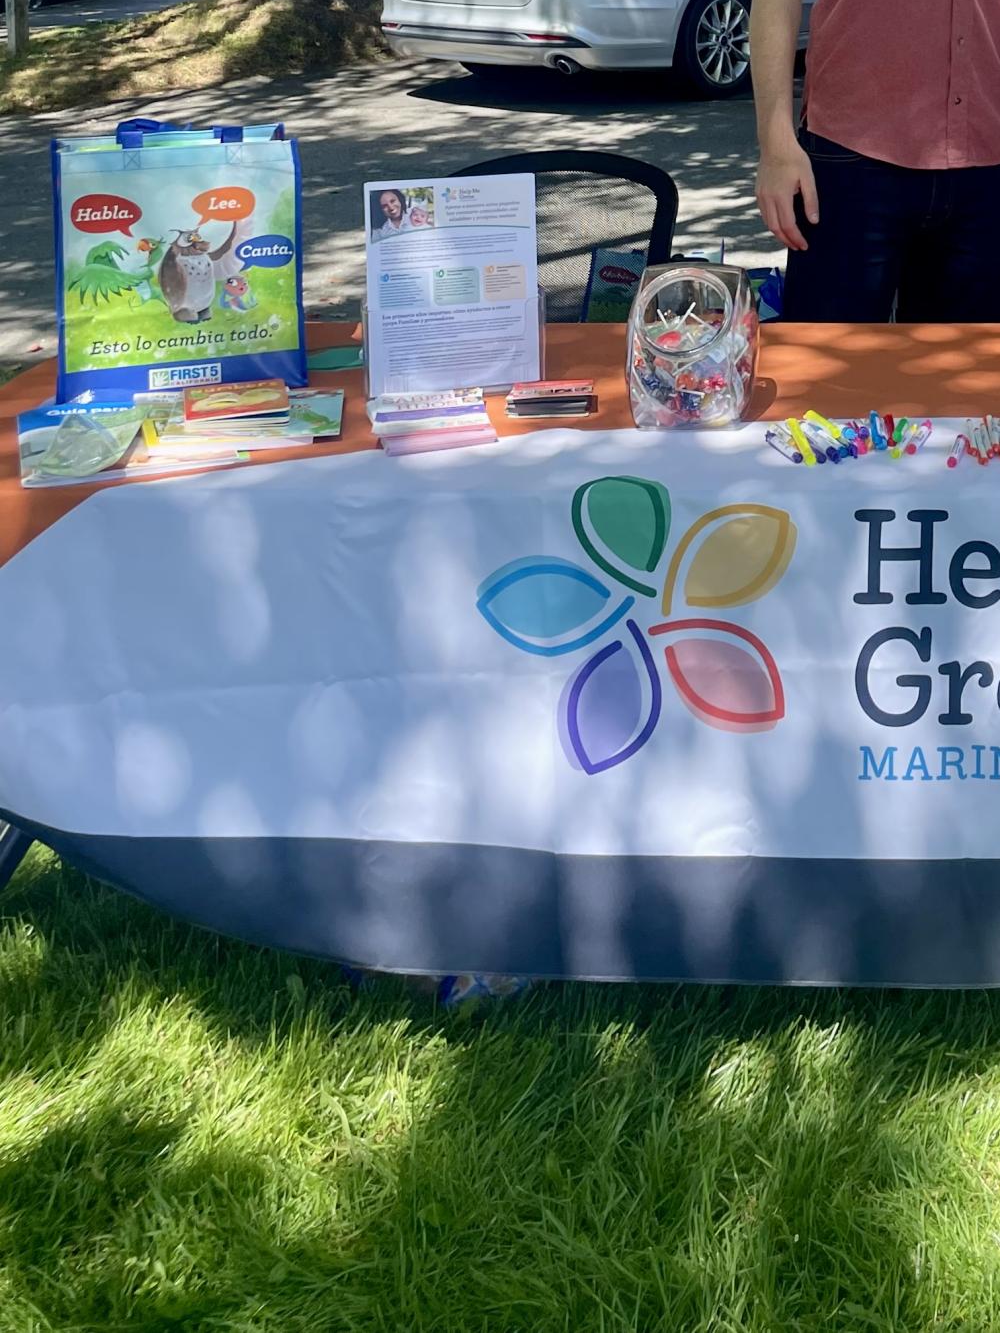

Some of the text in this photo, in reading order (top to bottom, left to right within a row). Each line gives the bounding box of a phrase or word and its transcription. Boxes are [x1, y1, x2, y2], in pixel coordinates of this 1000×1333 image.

[207, 196, 242, 211] Lee.
[75, 205, 135, 222] Habla.
[239, 243, 294, 259] Canta.
[89, 340, 130, 356] Esto
[136, 335, 152, 351] lo
[157, 329, 225, 349] cambia
[170, 364, 219, 380] FIRST 5
